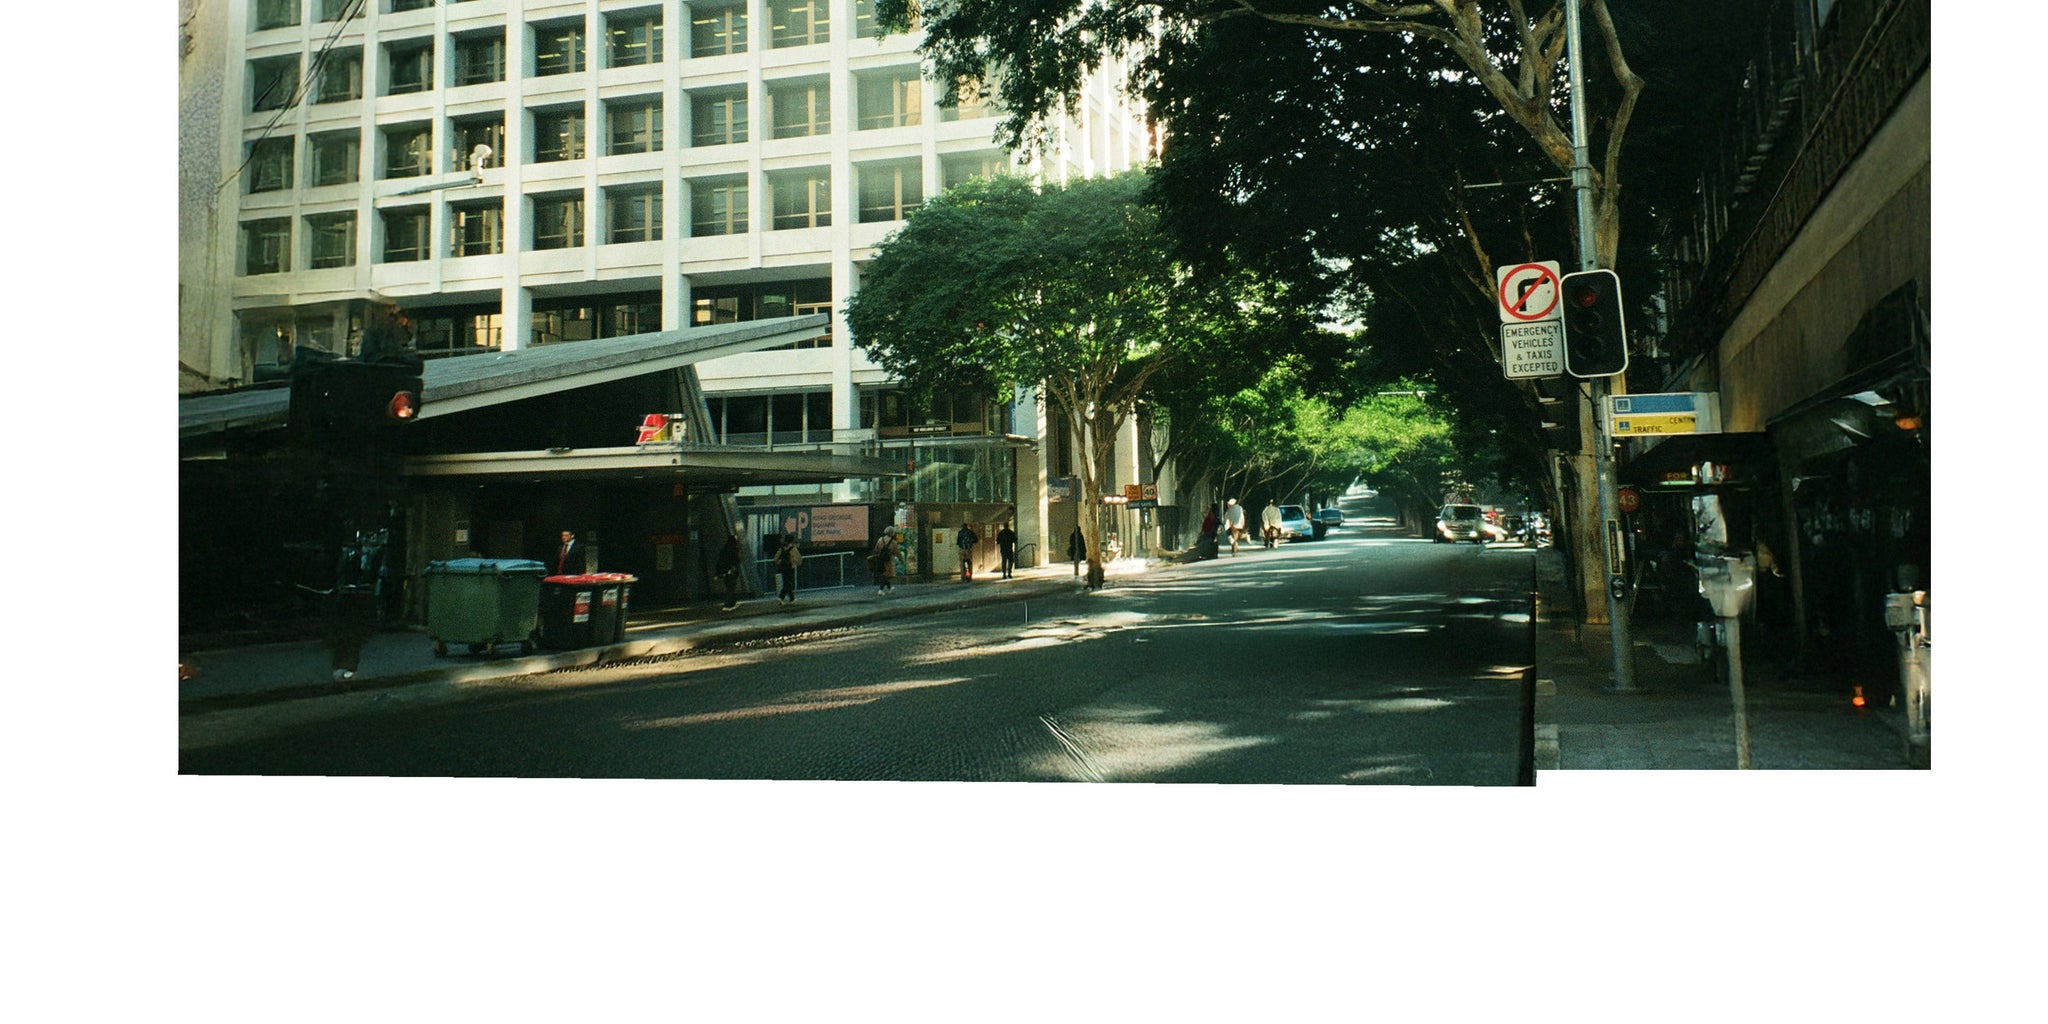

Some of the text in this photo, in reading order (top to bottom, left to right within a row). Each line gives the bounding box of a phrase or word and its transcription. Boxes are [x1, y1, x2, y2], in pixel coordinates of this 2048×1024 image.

[1505, 325, 1559, 338] EMERGENCY
[1512, 338, 1554, 349] VEHICLES
[1526, 350, 1552, 360] TAXIS
[1512, 361, 1558, 373] EXCEPTED
[1633, 425, 1662, 433] TRAFFIC
[1145, 488, 1154, 496] 40
